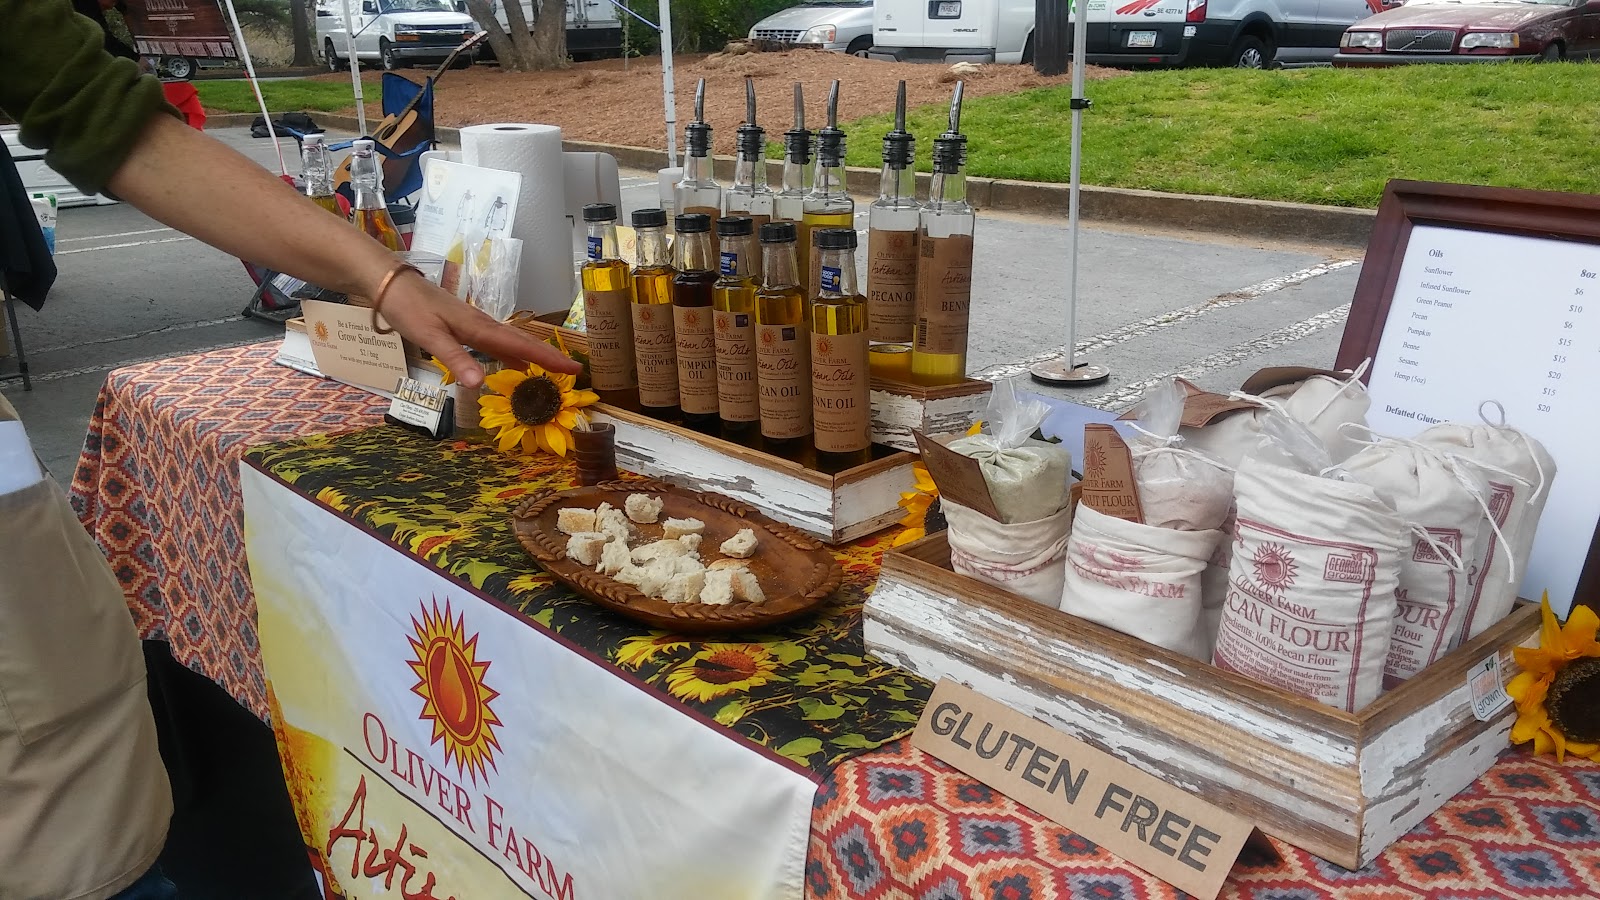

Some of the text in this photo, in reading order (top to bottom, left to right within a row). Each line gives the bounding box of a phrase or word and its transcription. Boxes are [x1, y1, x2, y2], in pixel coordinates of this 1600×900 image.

[1428, 249, 1444, 258] Oils
[1424, 266, 1454, 277] Sunflower
[1580, 268, 1597, 280] 8oz
[1420, 282, 1471, 296] Infused Sunflower
[1574, 287, 1584, 296] $6
[872, 290, 900, 302] PECAN
[942, 301, 968, 312] BENN
[1416, 296, 1453, 309] Green Peanut
[1569, 304, 1583, 314] $10
[1412, 312, 1428, 321] Pecan
[348, 322, 364, 331] Friend
[1564, 320, 1573, 330] $6
[1407, 326, 1432, 338] Pumpkin
[338, 330, 356, 342] Grow
[358, 334, 398, 350] Sunflowers
[1558, 338, 1572, 347] $15
[1402, 342, 1420, 351] Benne
[360, 348, 366, 356] $2
[370, 351, 379, 360] bag
[1552, 354, 1566, 364] $15
[1398, 356, 1418, 367] Sesame
[688, 370, 704, 380] OIL
[718, 371, 754, 381] NUT OIL
[1394, 371, 1426, 385] Hemp (5oz)
[1548, 370, 1562, 380] $20
[760, 386, 800, 397] CAN OIL
[1542, 387, 1556, 396] $15
[814, 397, 856, 410] NNE OIL
[1536, 403, 1550, 413] $20
[1386, 404, 1416, 418] Defatted
[1101, 478, 1124, 488] FARM
[1084, 495, 1135, 507] NUT FLOUR
[1328, 557, 1362, 574] GEORGIA
[1328, 571, 1362, 580] grown
[1125, 576, 1186, 598] FARM
[1236, 574, 1317, 620] OLIVER FARM
[1228, 589, 1350, 652] CAN FLOUR
[1393, 604, 1440, 630] OUR
[1394, 625, 1424, 642] Flour
[1256, 629, 1276, 650] 100%
[1278, 644, 1304, 662] Pecan
[1308, 654, 1338, 666] Flour
[1396, 644, 1414, 656] from
[1260, 653, 1278, 668] baking
[1278, 663, 1292, 674] flour
[1293, 670, 1312, 680] made
[1313, 674, 1331, 682] from
[1400, 663, 1416, 672] cake
[1306, 682, 1329, 690] recipes
[1314, 686, 1320, 695] &
[1321, 688, 1338, 698] cake
[1478, 690, 1500, 714] grown
[930, 702, 1222, 873] GLUTEN FREE
[363, 712, 574, 900] OLIVER FARM
